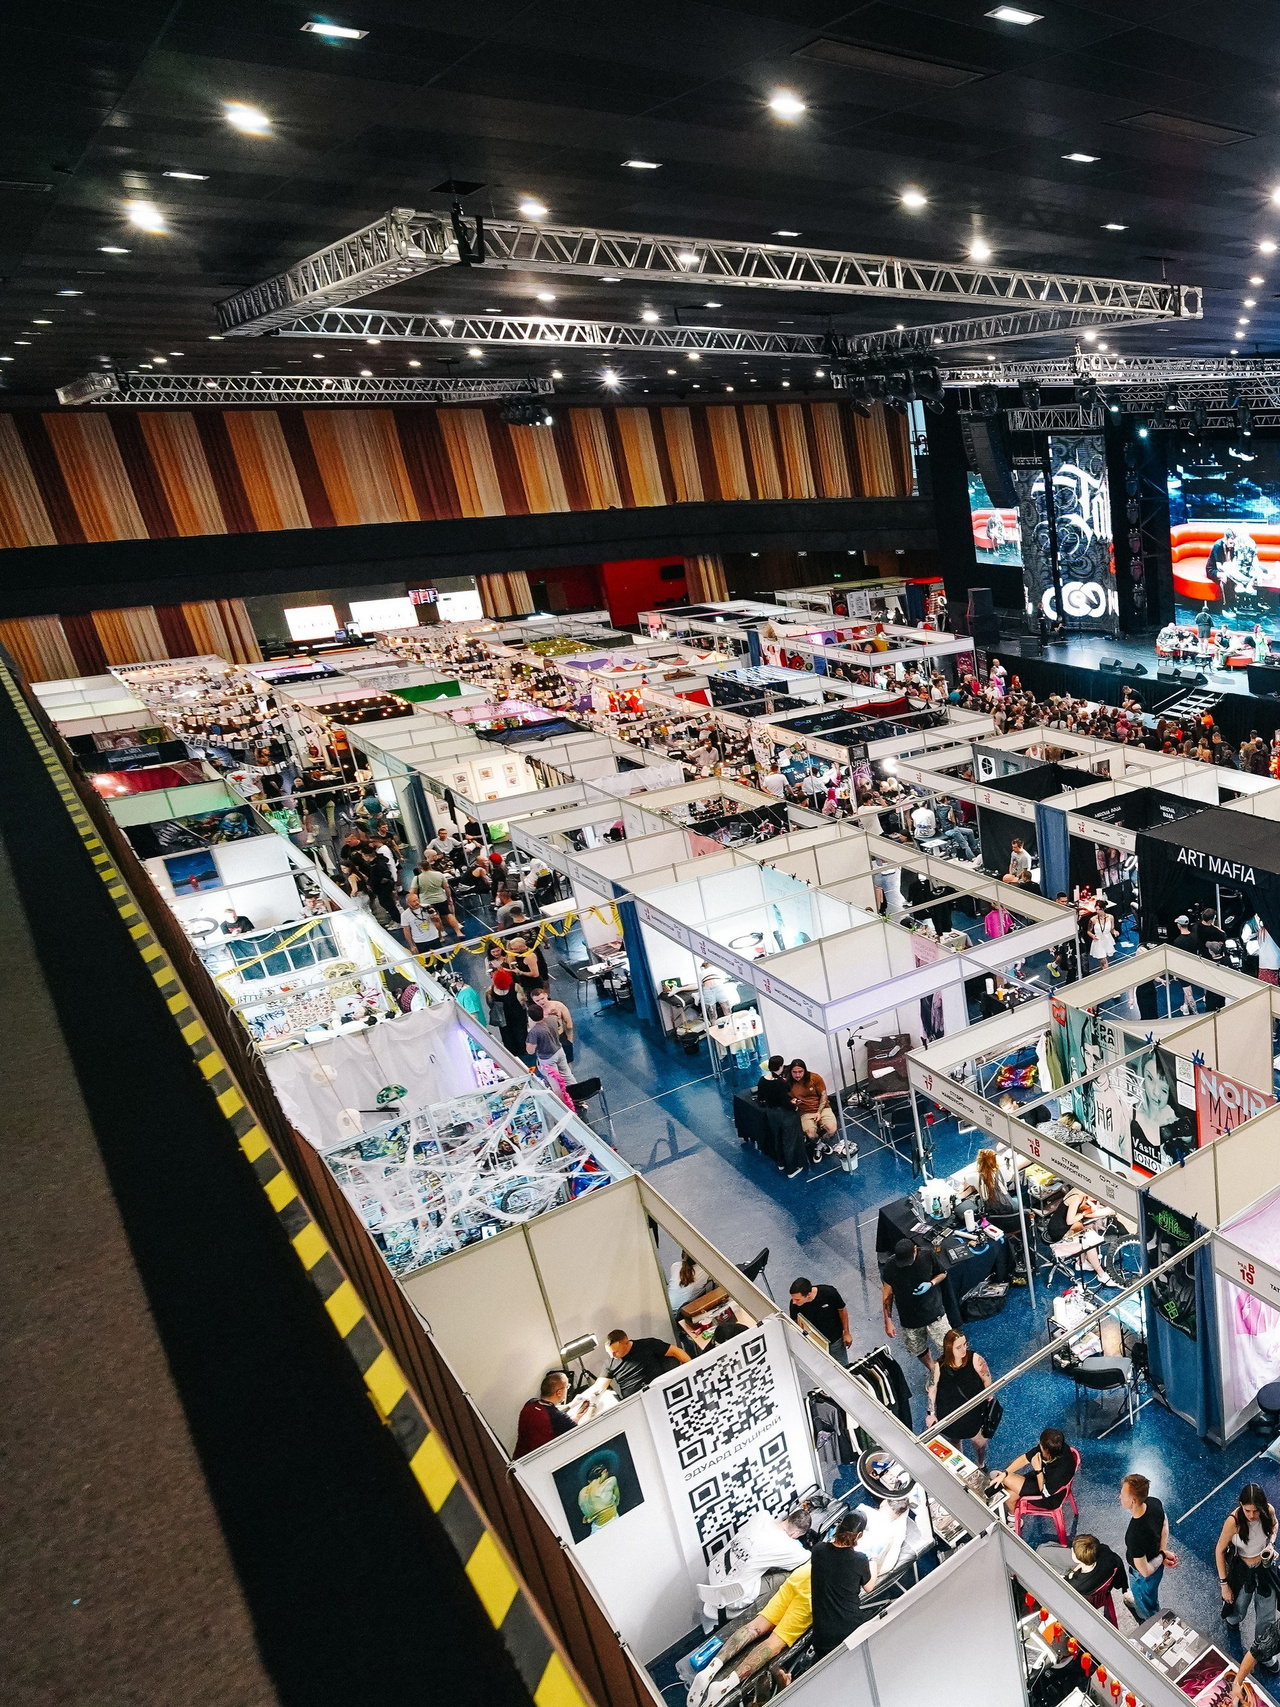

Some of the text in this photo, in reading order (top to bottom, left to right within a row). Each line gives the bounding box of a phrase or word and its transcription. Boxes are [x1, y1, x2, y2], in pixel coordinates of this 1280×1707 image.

[1177, 847, 1256, 885] ART MAFIA
[925, 1080, 932, 1091] 17
[1029, 1144, 1040, 1157] 18
[1240, 1269, 1254, 1285] 19
[684, 1415, 782, 1482] ЭДУАРД ДУШНЫЙ
